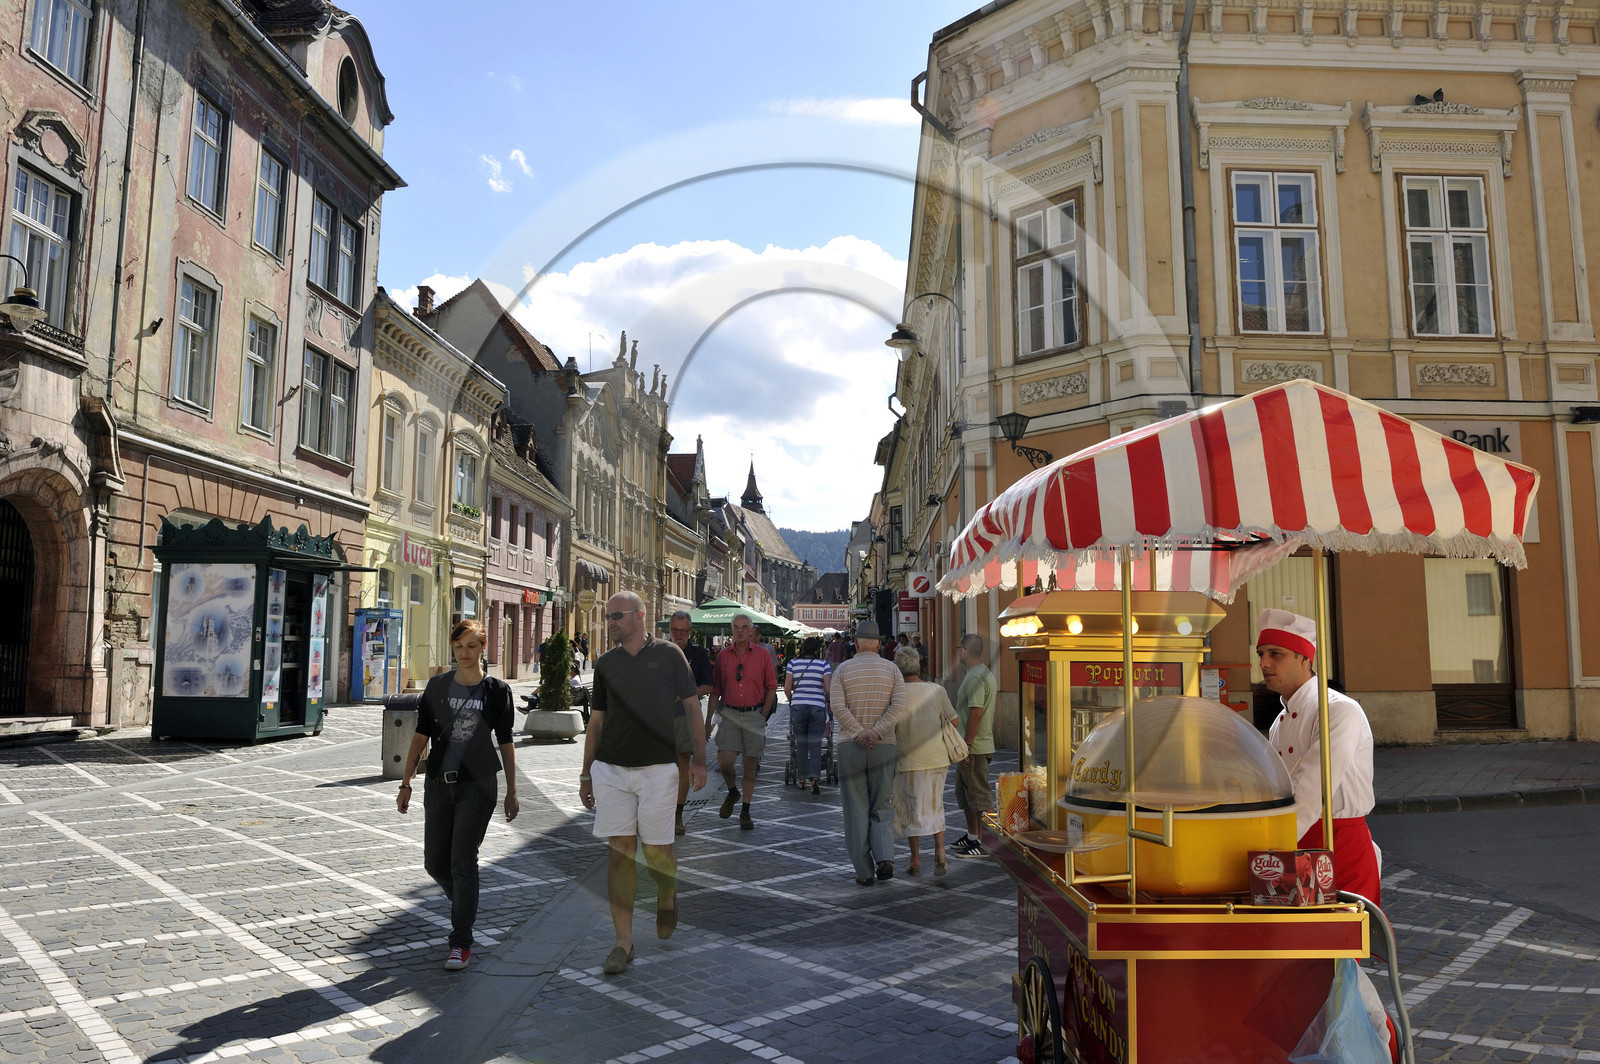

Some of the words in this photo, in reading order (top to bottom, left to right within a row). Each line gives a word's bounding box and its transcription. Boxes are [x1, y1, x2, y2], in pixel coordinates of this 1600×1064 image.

[1085, 664, 1165, 685] Poporn
[1073, 757, 1123, 791] Candy
[1254, 855, 1280, 871] gala
[1317, 856, 1331, 878] gala
[1067, 943, 1117, 1016] COTTON
[1081, 996, 1126, 1063] CANDY
